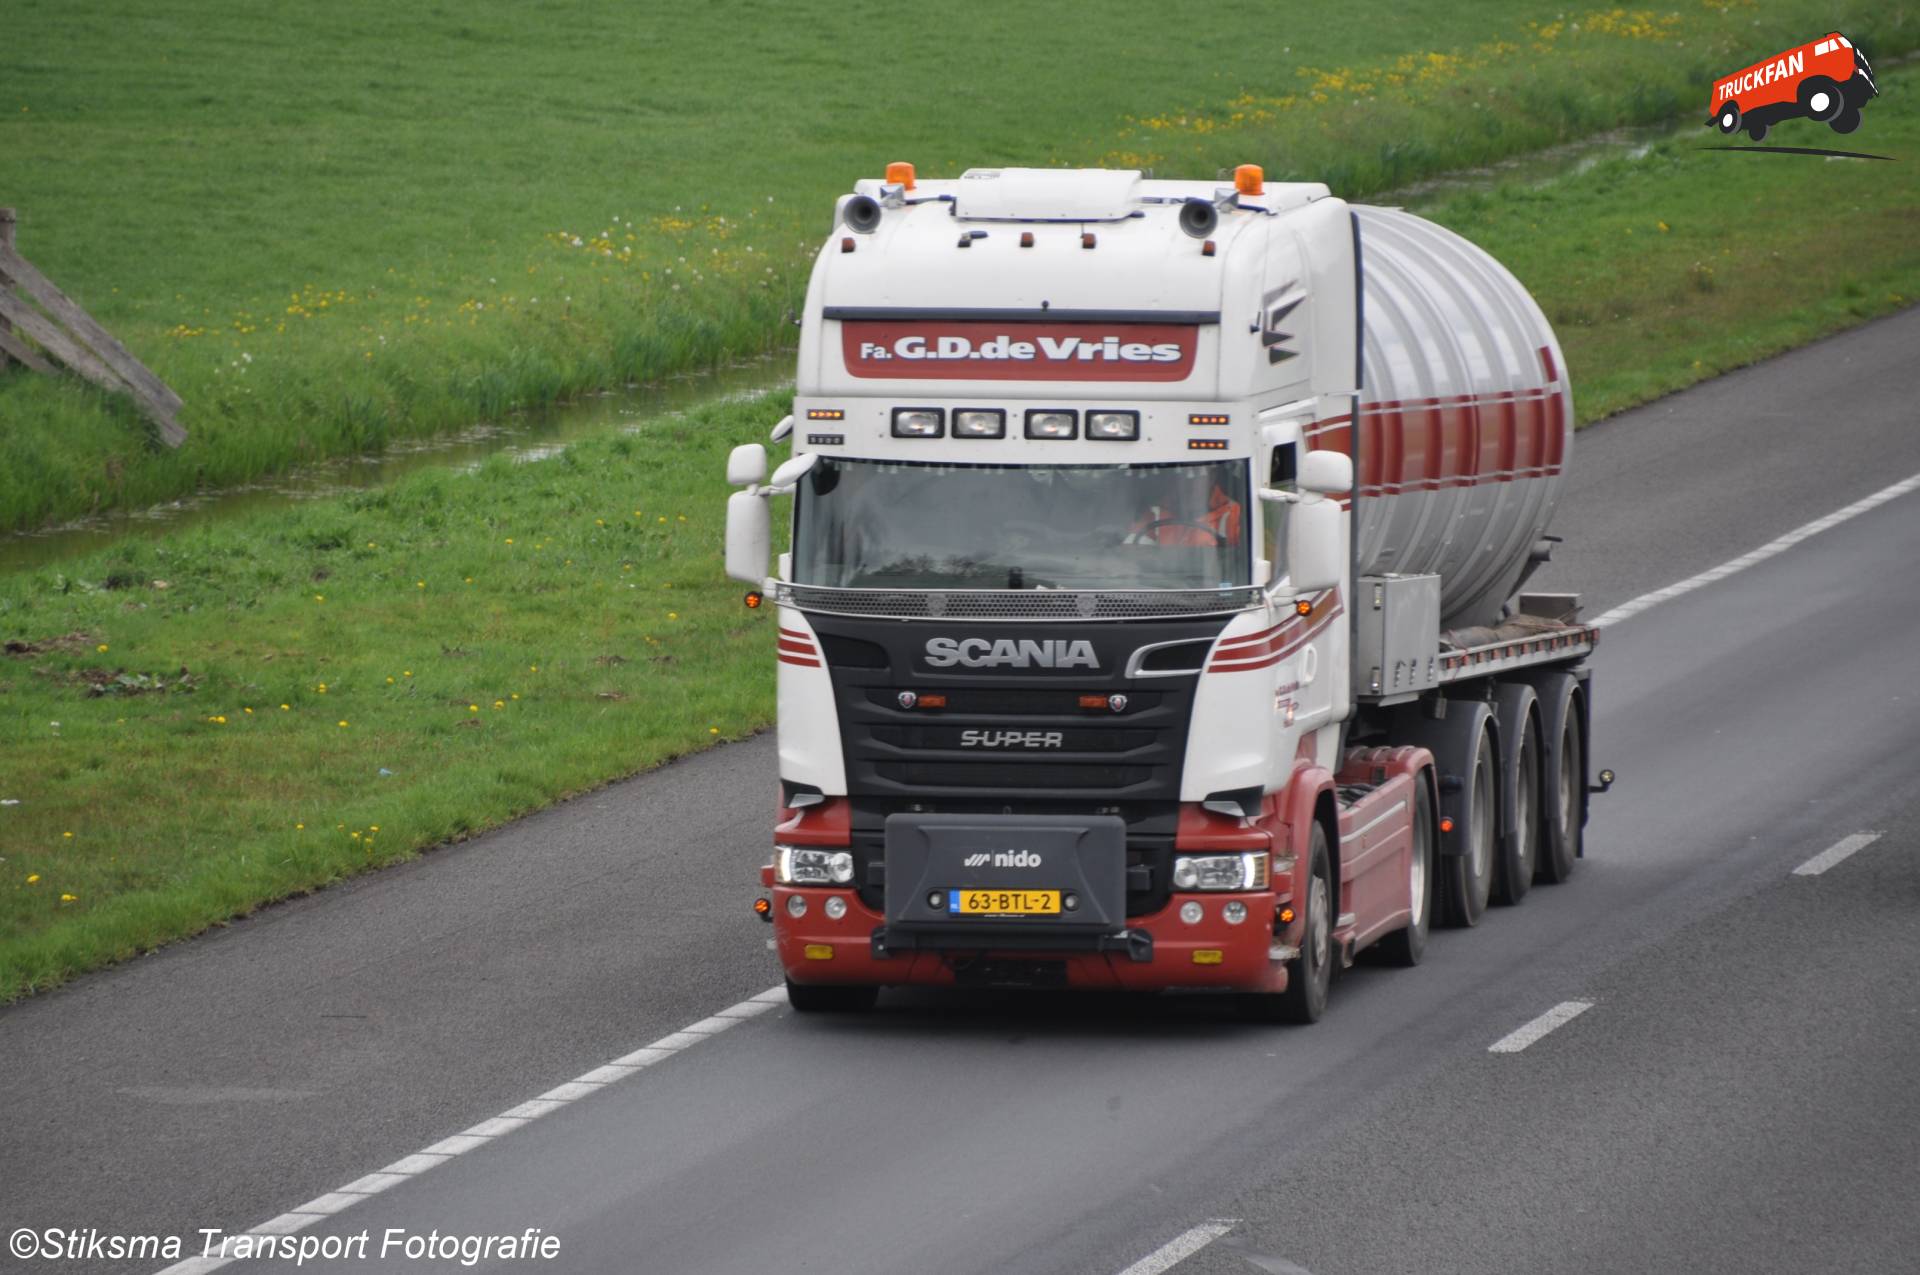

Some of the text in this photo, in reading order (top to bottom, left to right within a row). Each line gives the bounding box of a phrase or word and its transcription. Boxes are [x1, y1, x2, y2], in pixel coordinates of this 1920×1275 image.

[860, 343, 892, 359] Fa.
[1037, 337, 1182, 362] Vries
[924, 637, 1101, 669] SCANIA
[960, 730, 1063, 748] SUPER
[995, 849, 1042, 868] nido
[968, 893, 1052, 911] 63-BTL-2
